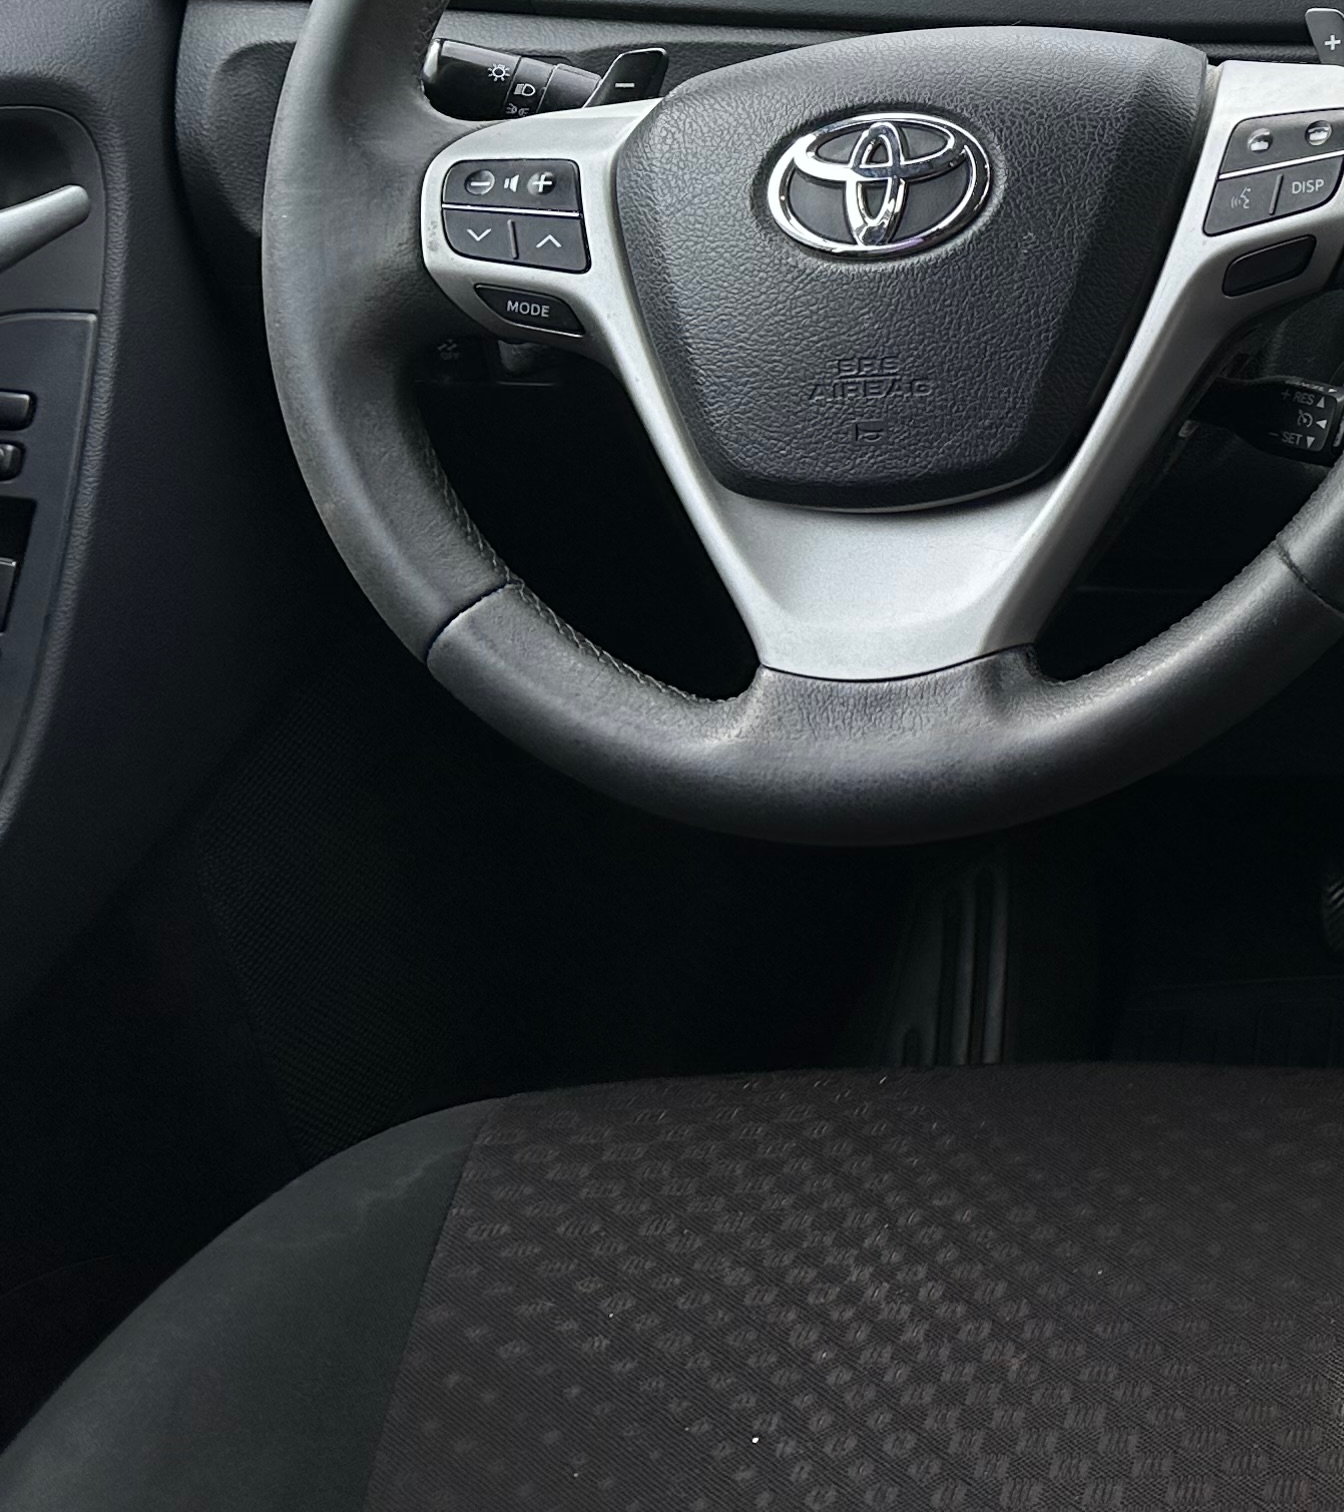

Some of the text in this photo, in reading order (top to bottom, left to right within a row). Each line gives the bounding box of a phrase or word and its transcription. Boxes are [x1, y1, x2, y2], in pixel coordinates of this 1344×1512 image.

[1291, 176, 1325, 197] DISP
[506, 299, 550, 318] MODE
[1292, 391, 1316, 406] RES
[1281, 431, 1303, 446] SET
